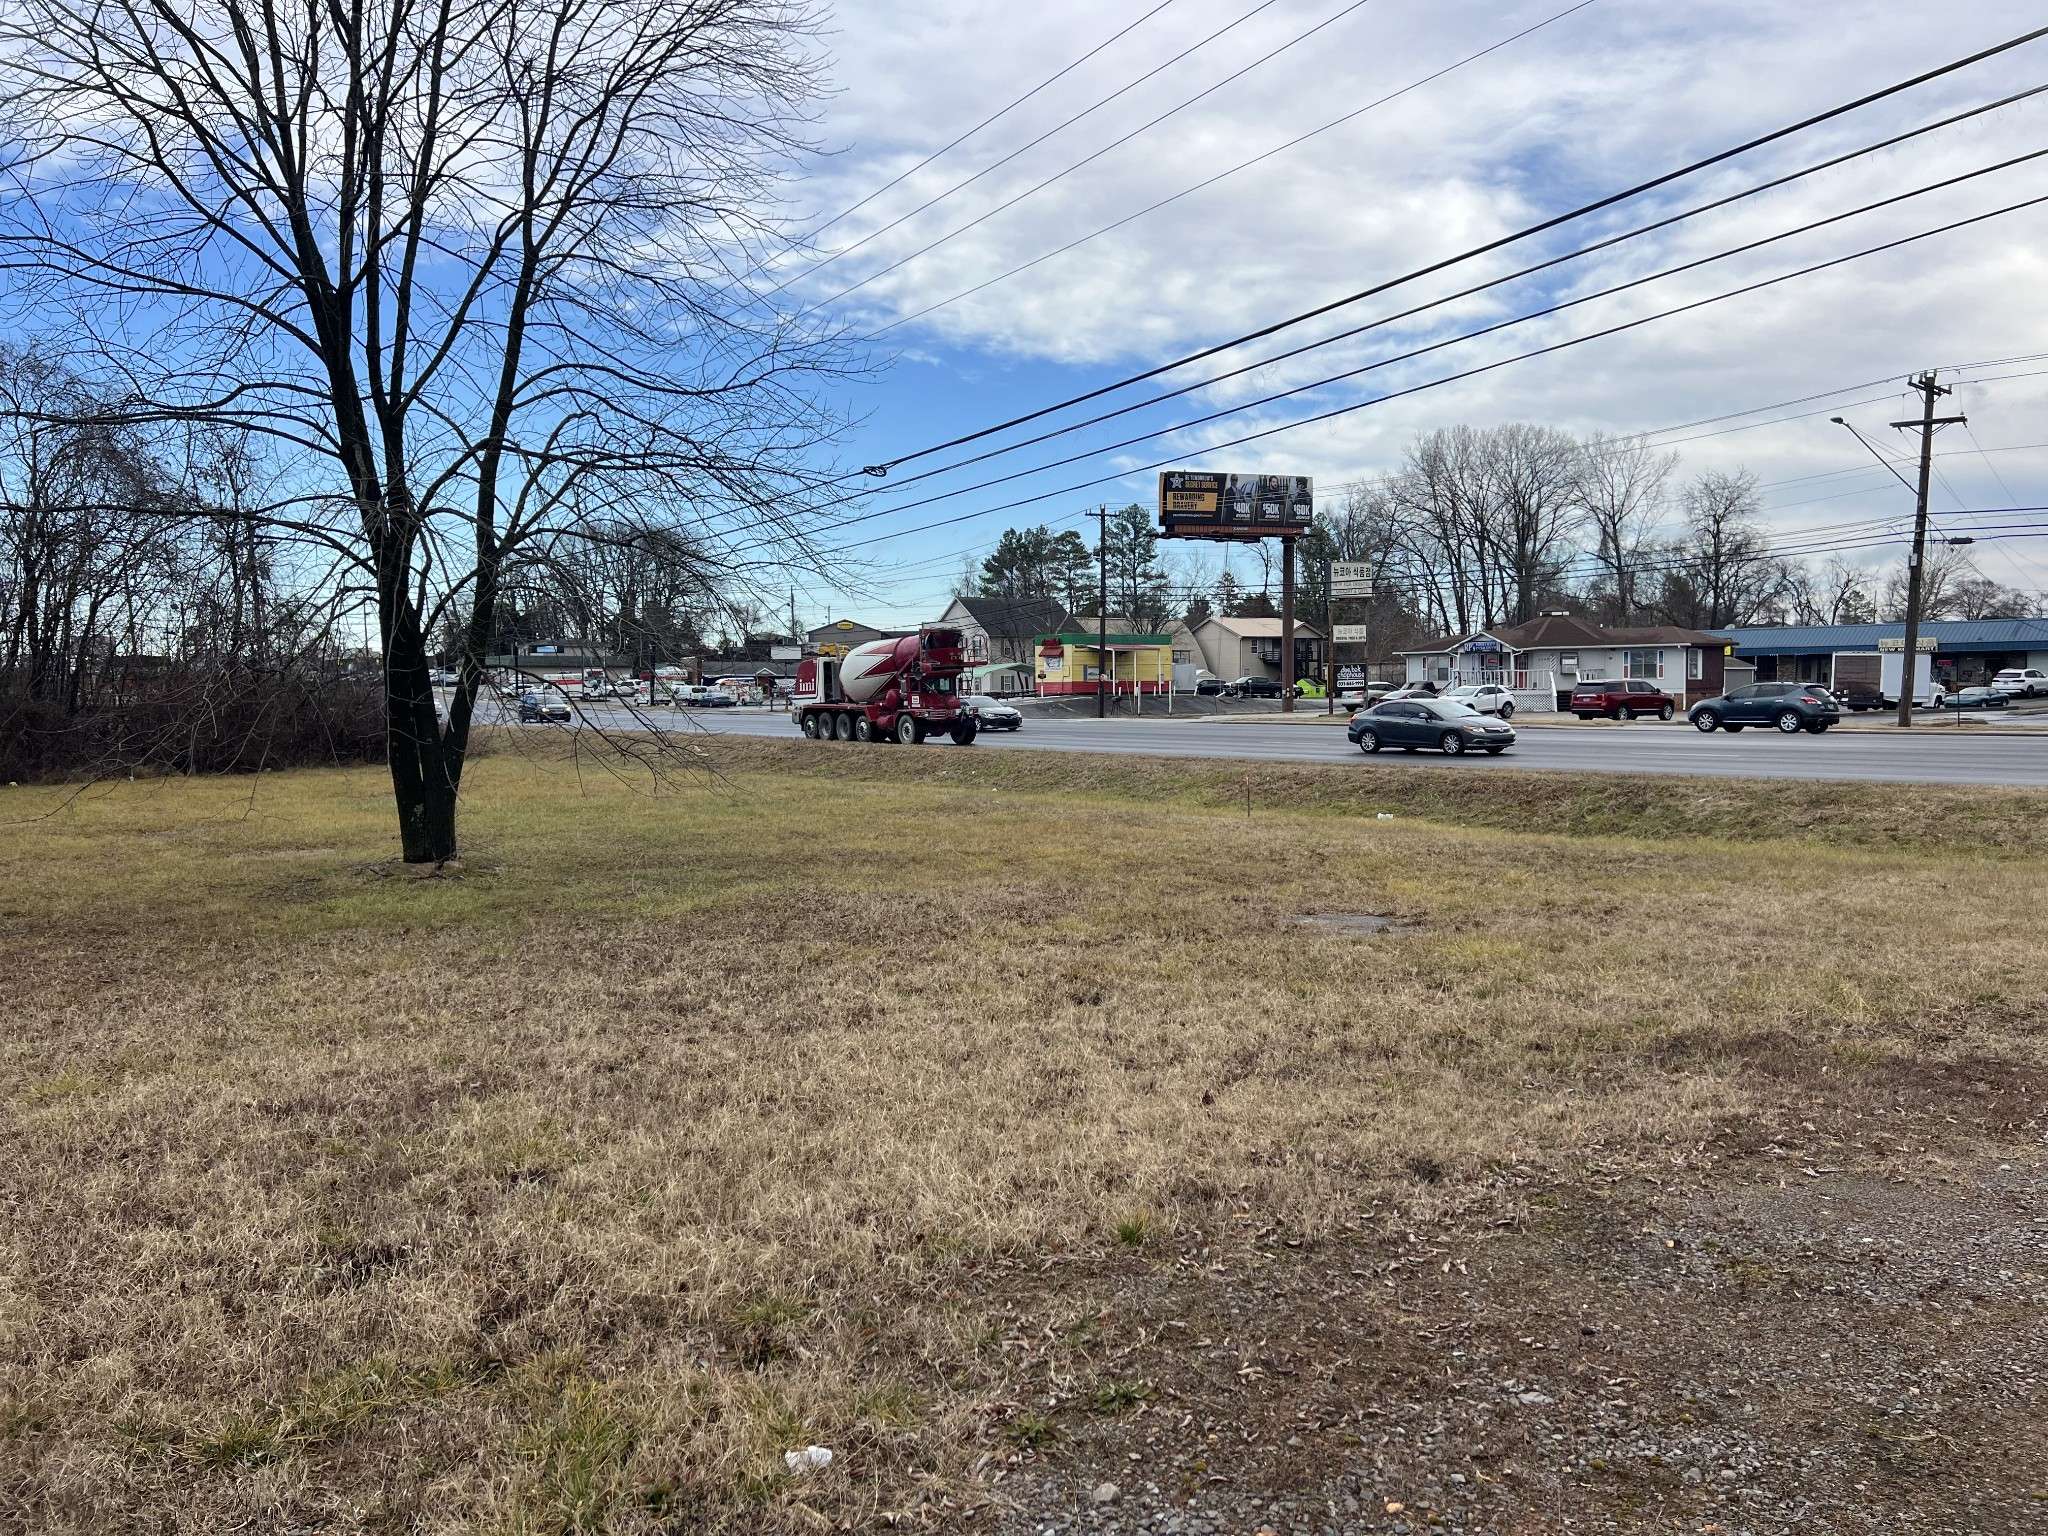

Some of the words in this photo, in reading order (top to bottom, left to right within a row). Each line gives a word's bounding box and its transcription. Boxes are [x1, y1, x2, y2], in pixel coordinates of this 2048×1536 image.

[1172, 492, 1205, 501] REWARDING
[1233, 502, 1251, 513] $40K
[1262, 503, 1280, 514] $50K
[1293, 504, 1310, 515] $60K
[799, 678, 815, 692] imi
